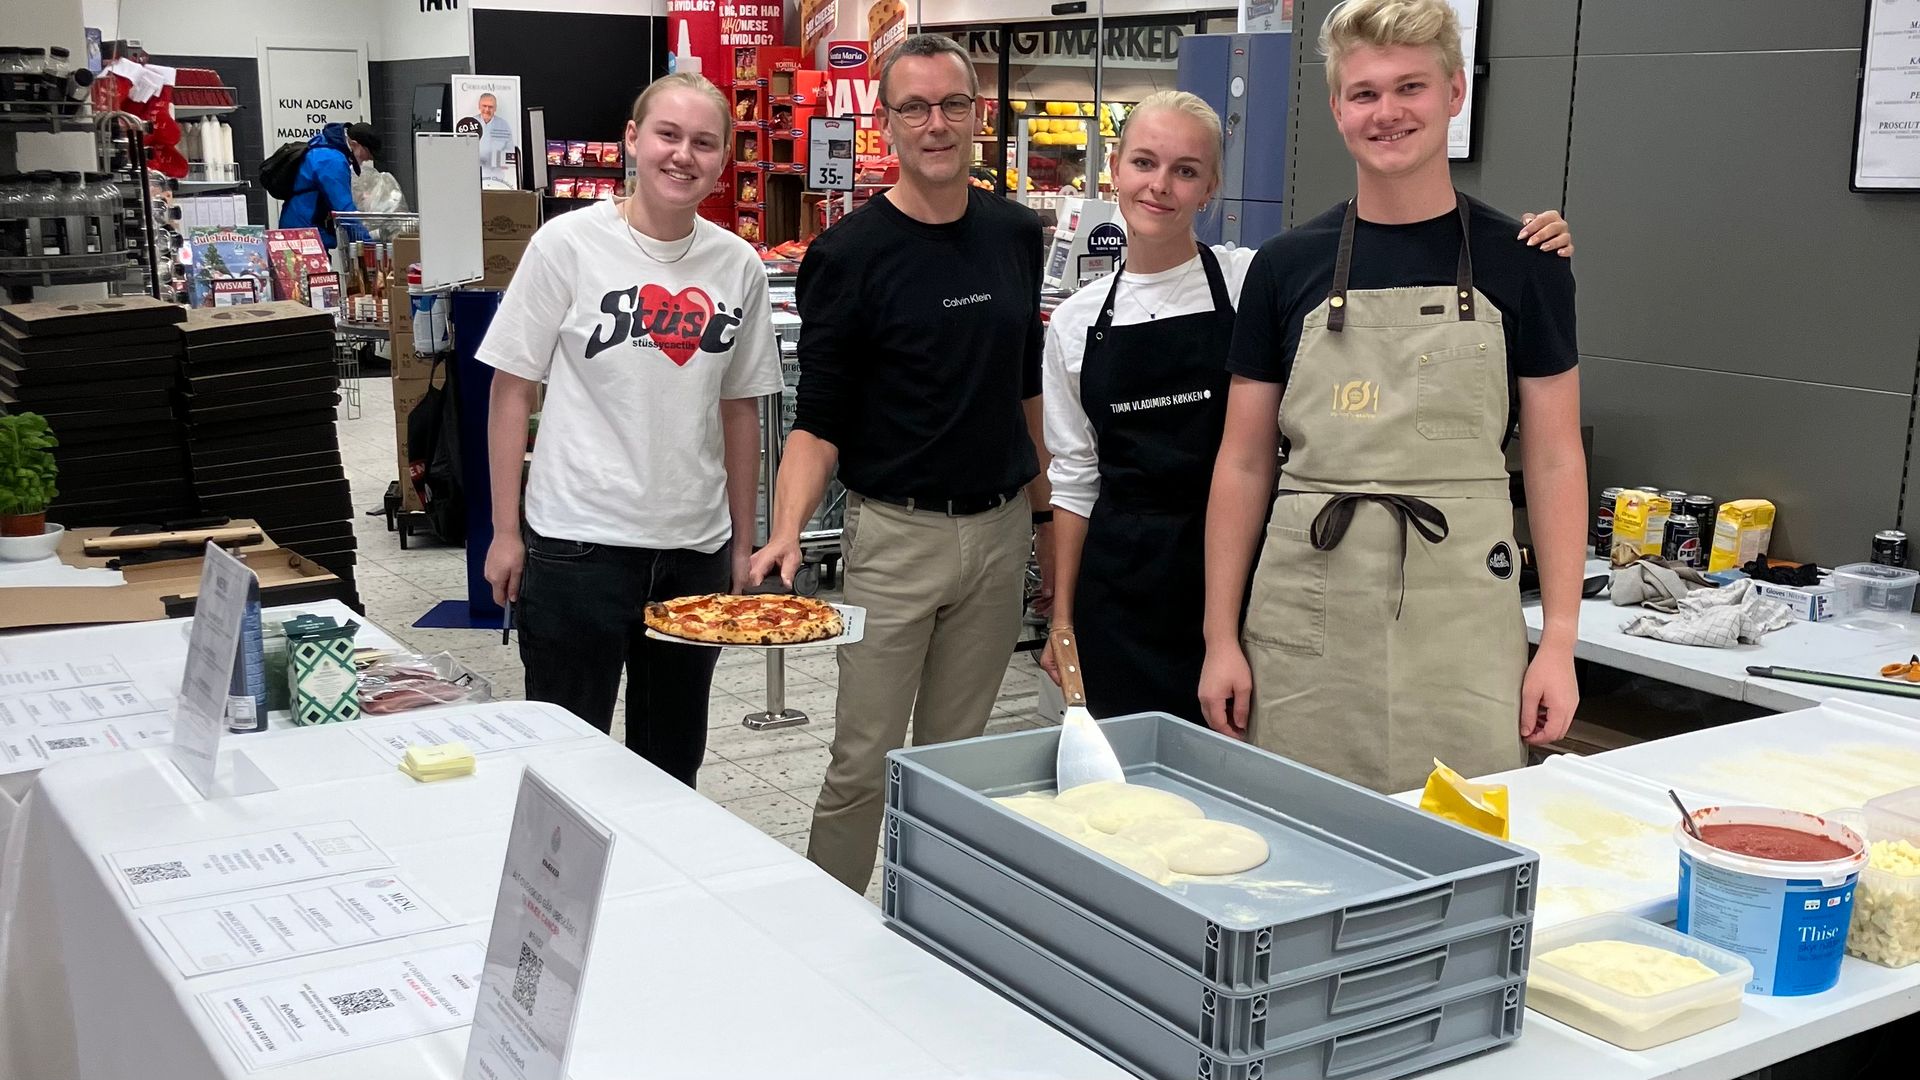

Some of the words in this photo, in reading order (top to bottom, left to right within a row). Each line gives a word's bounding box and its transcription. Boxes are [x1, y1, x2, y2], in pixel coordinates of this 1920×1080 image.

[740, 6, 758, 16] DER
[761, 6, 780, 16] HAR
[730, 34, 774, 46] HVIDLØG?
[842, 52, 862, 60] Maria
[280, 98, 302, 108] KUN
[306, 99, 352, 109] ADGANG
[306, 114, 327, 124] FOR
[458, 124, 468, 132] 60
[470, 122, 478, 130] år
[193, 232, 262, 246] Julekalender
[311, 275, 338, 284] AVISVARE
[215, 281, 252, 290] AVISVARE
[942, 297, 970, 308] Calvin
[970, 292, 992, 303] Klein
[1132, 396, 1172, 410] VLADIMIRS
[1172, 390, 1203, 404] KØKKEN
[1766, 587, 1786, 597] Gloves
[1788, 590, 1808, 601] Nitrile
[388, 892, 418, 912] MENU
[1798, 925, 1838, 942] Thise
[280, 1003, 305, 1029] ByOverbeck
[250, 1021, 262, 1032] FOR
